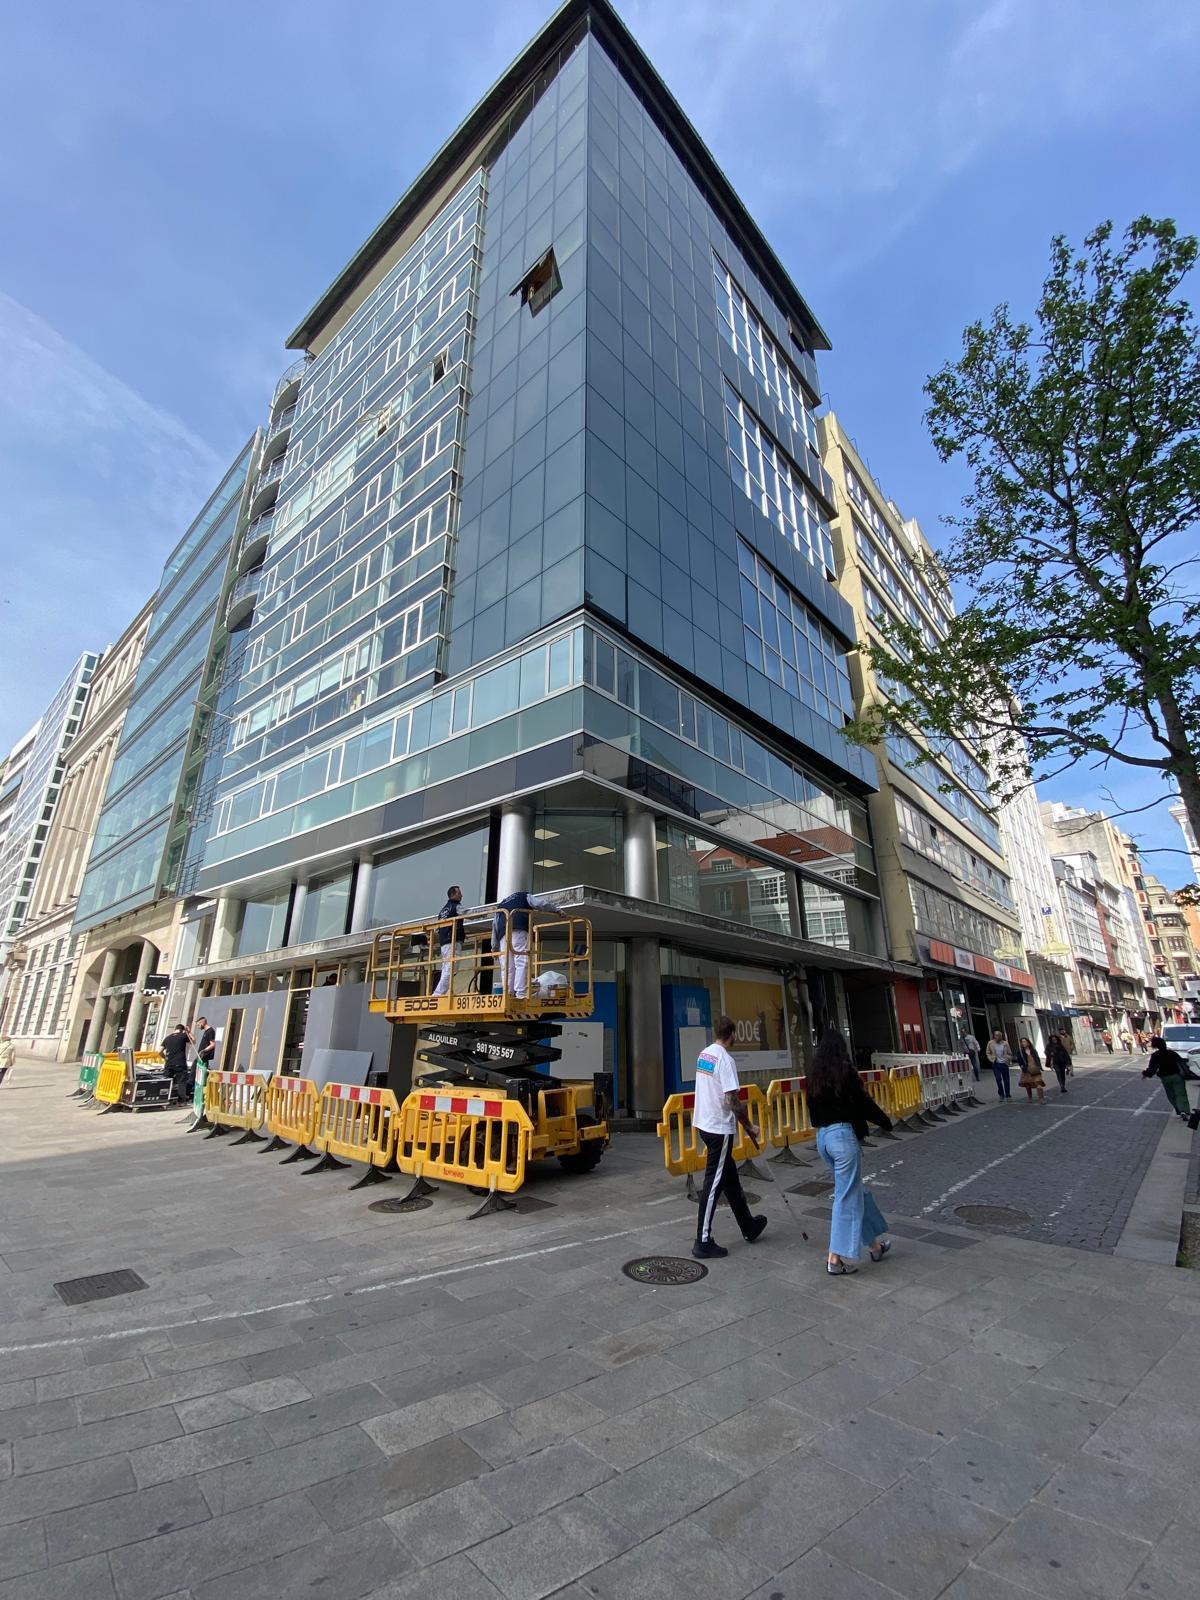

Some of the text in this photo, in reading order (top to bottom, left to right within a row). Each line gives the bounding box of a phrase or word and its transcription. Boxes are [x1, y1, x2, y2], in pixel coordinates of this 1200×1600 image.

[457, 995, 503, 1010] 981 795 567
[732, 1020, 762, 1042] 00€
[428, 1033, 458, 1047] ALQUILER
[476, 1042, 514, 1060] 981 795 567
